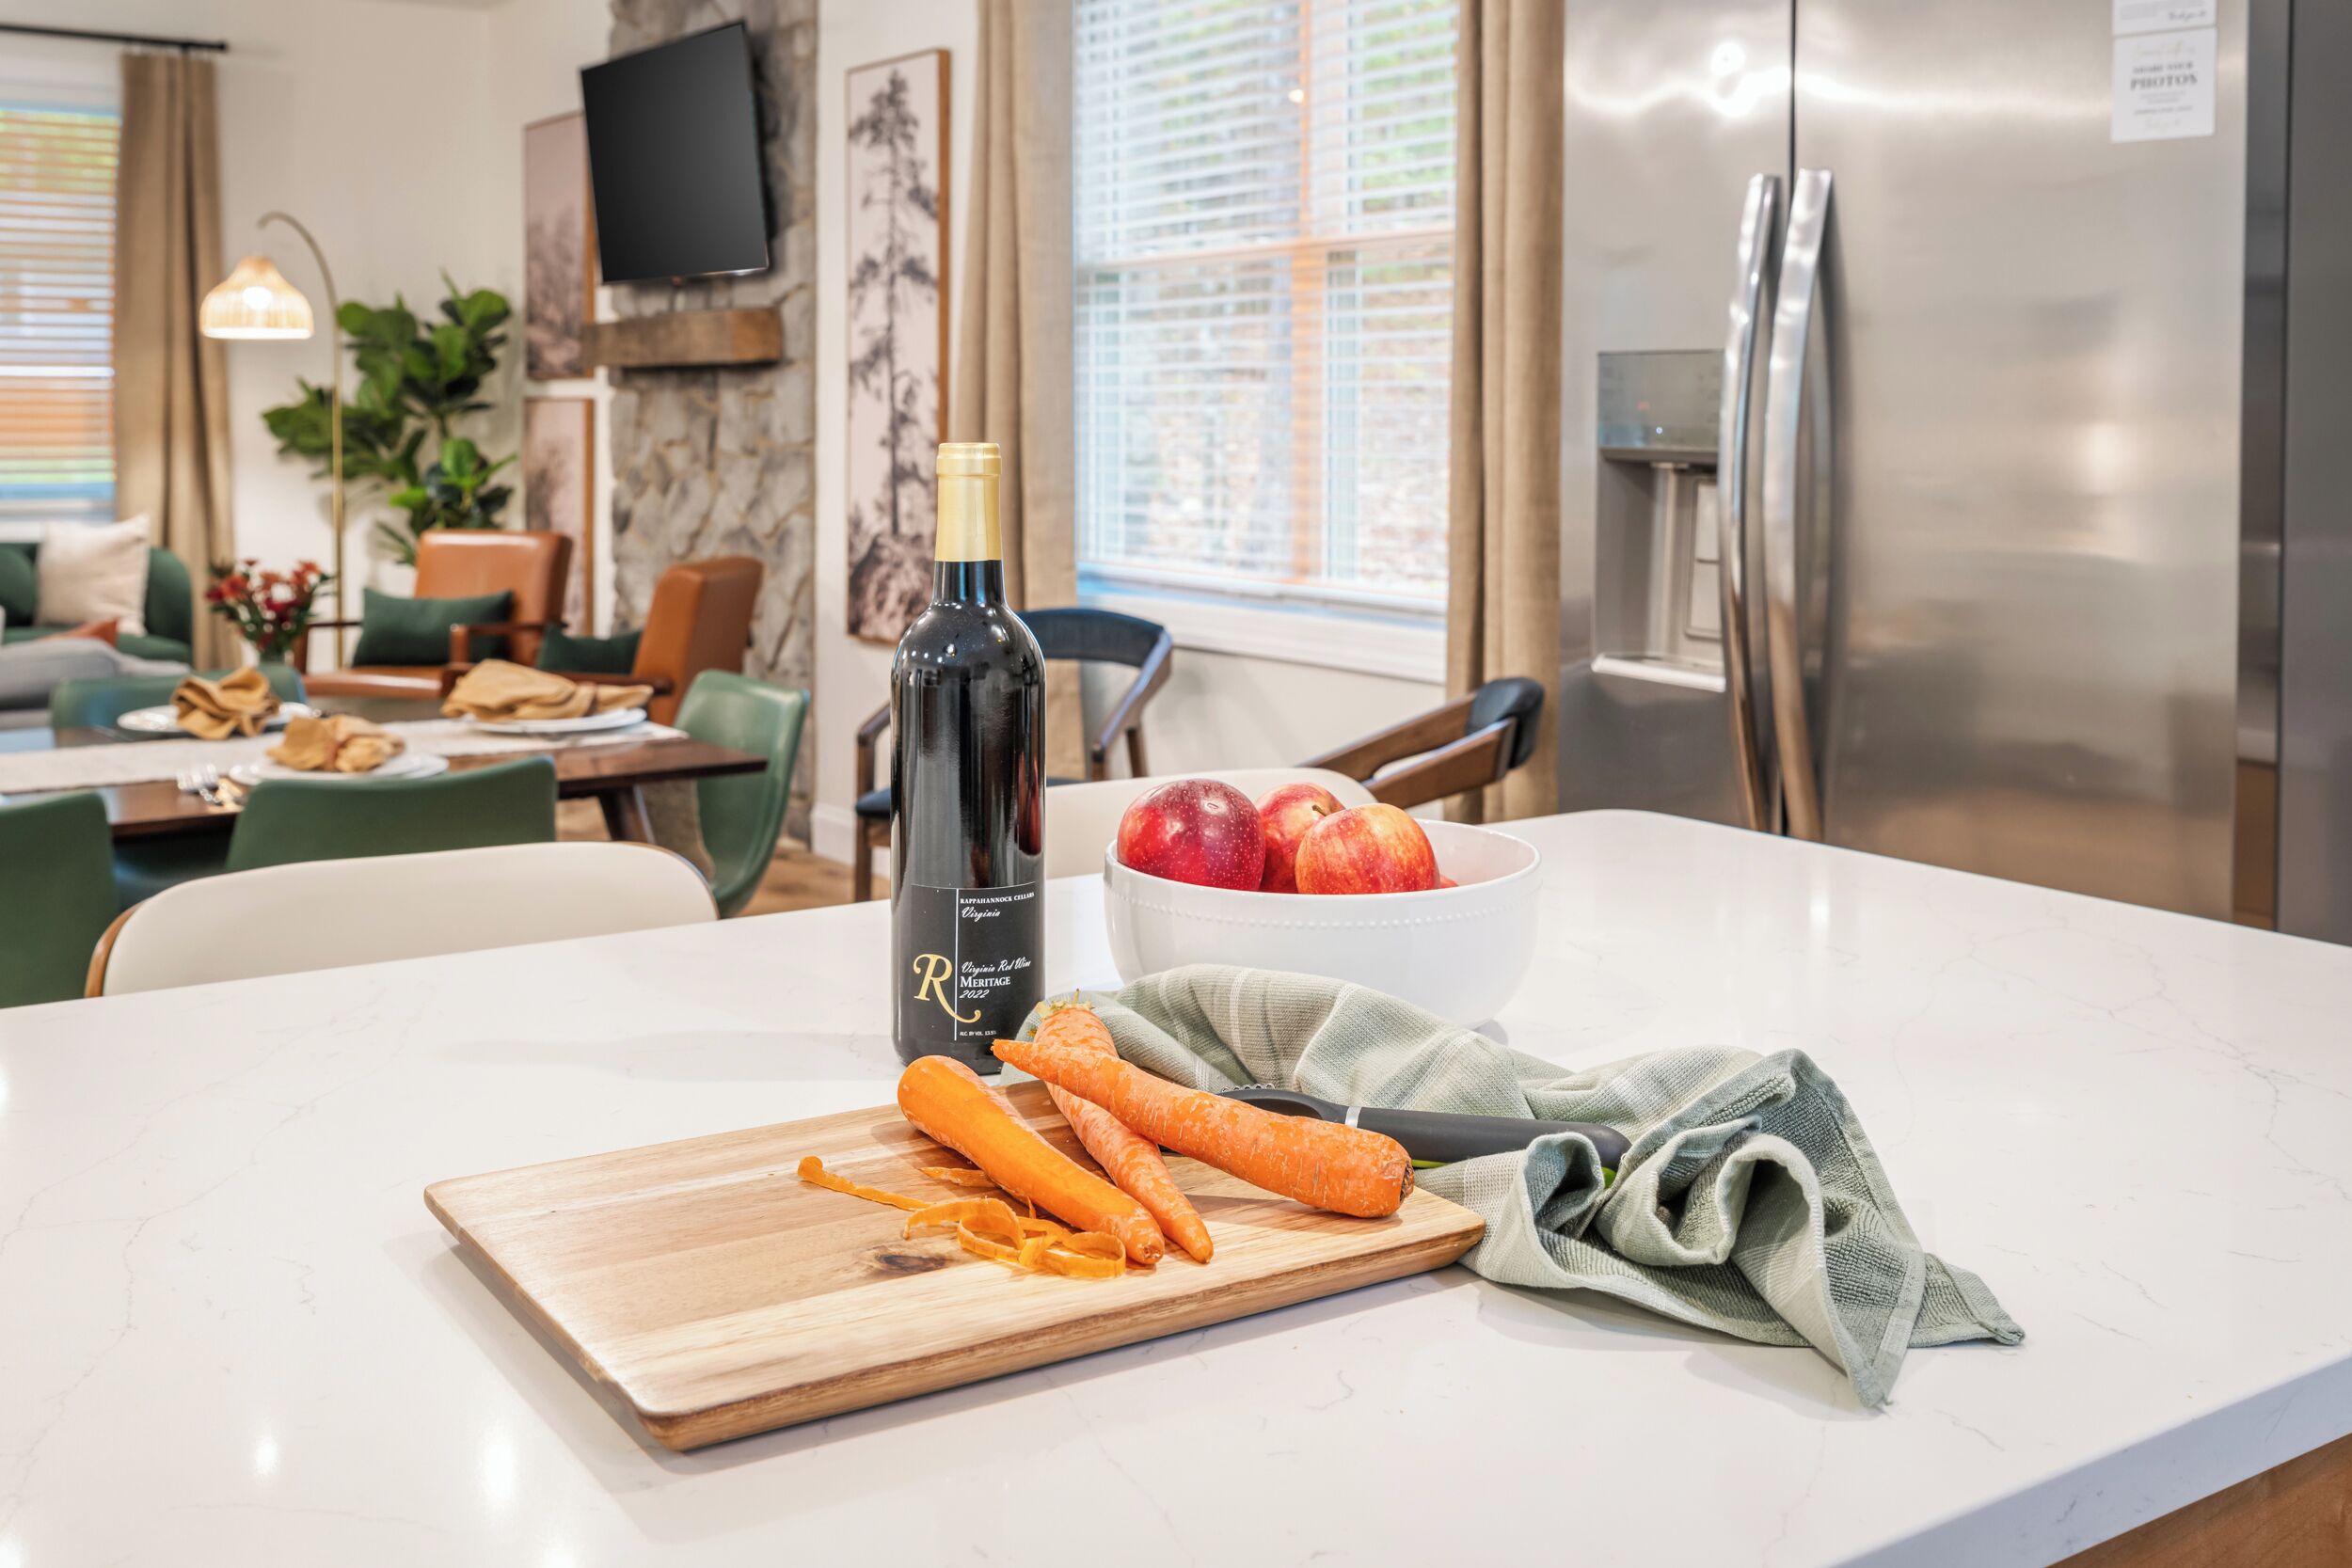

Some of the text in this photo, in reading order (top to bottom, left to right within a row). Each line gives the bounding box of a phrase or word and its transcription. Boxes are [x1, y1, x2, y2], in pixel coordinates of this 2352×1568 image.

[2129, 73, 2199, 92] PHOTOS
[960, 891, 1035, 904] RAPPAHANNOCK CELLARS
[961, 906, 1001, 923] Virginia
[961, 956, 1032, 977] Virginia Red Wine
[913, 953, 982, 1023] R
[959, 989, 991, 999] 2022
